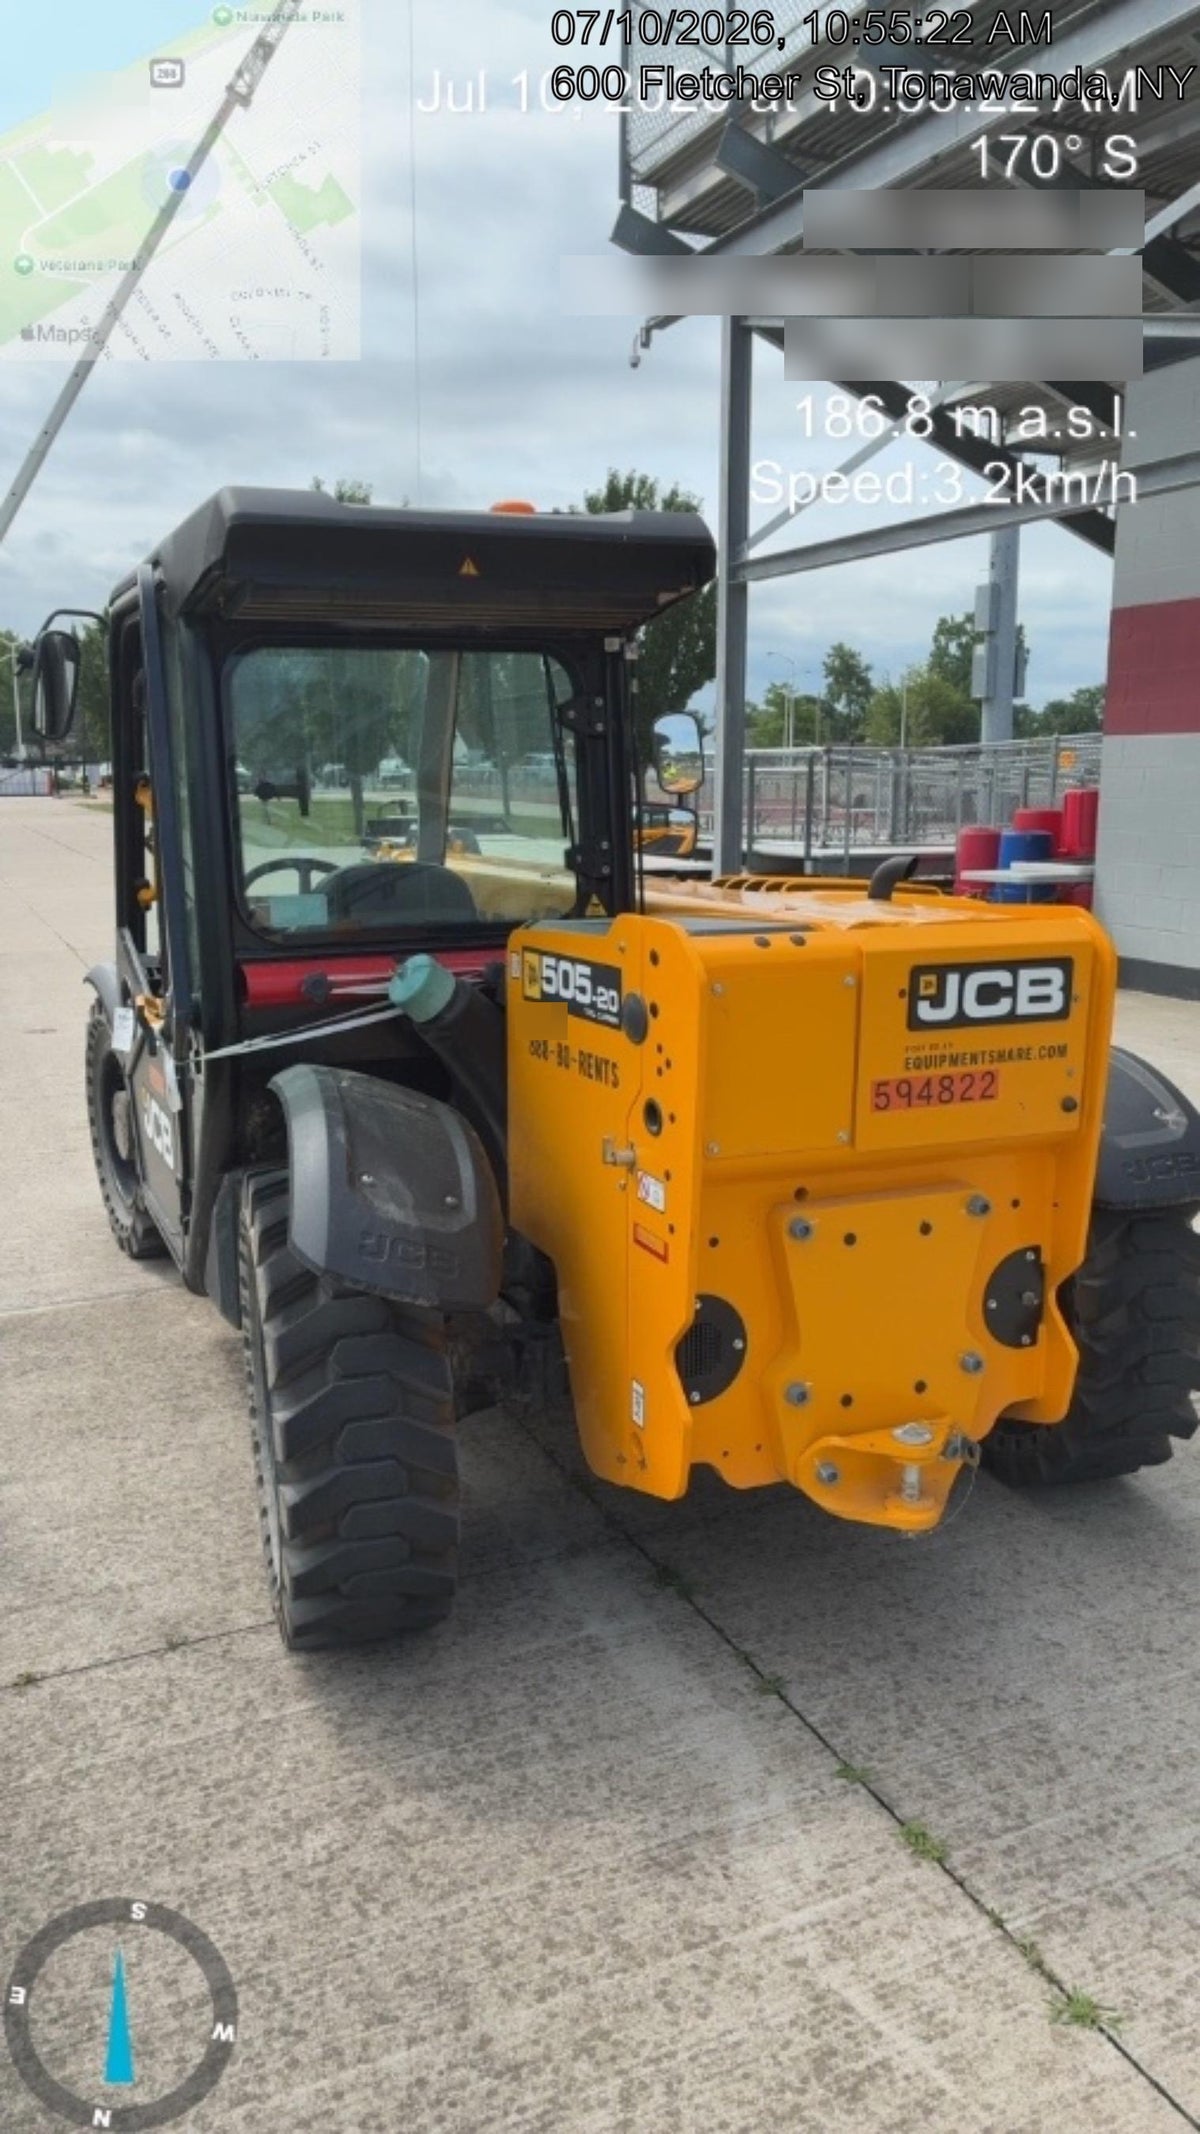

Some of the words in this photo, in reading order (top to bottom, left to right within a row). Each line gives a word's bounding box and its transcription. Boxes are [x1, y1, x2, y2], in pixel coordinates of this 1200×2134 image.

[916, 967, 1065, 1022] JCB
[904, 1043, 1068, 1070] EQUIPMENTSHARE.COM
[873, 1071, 996, 1111] 594822
